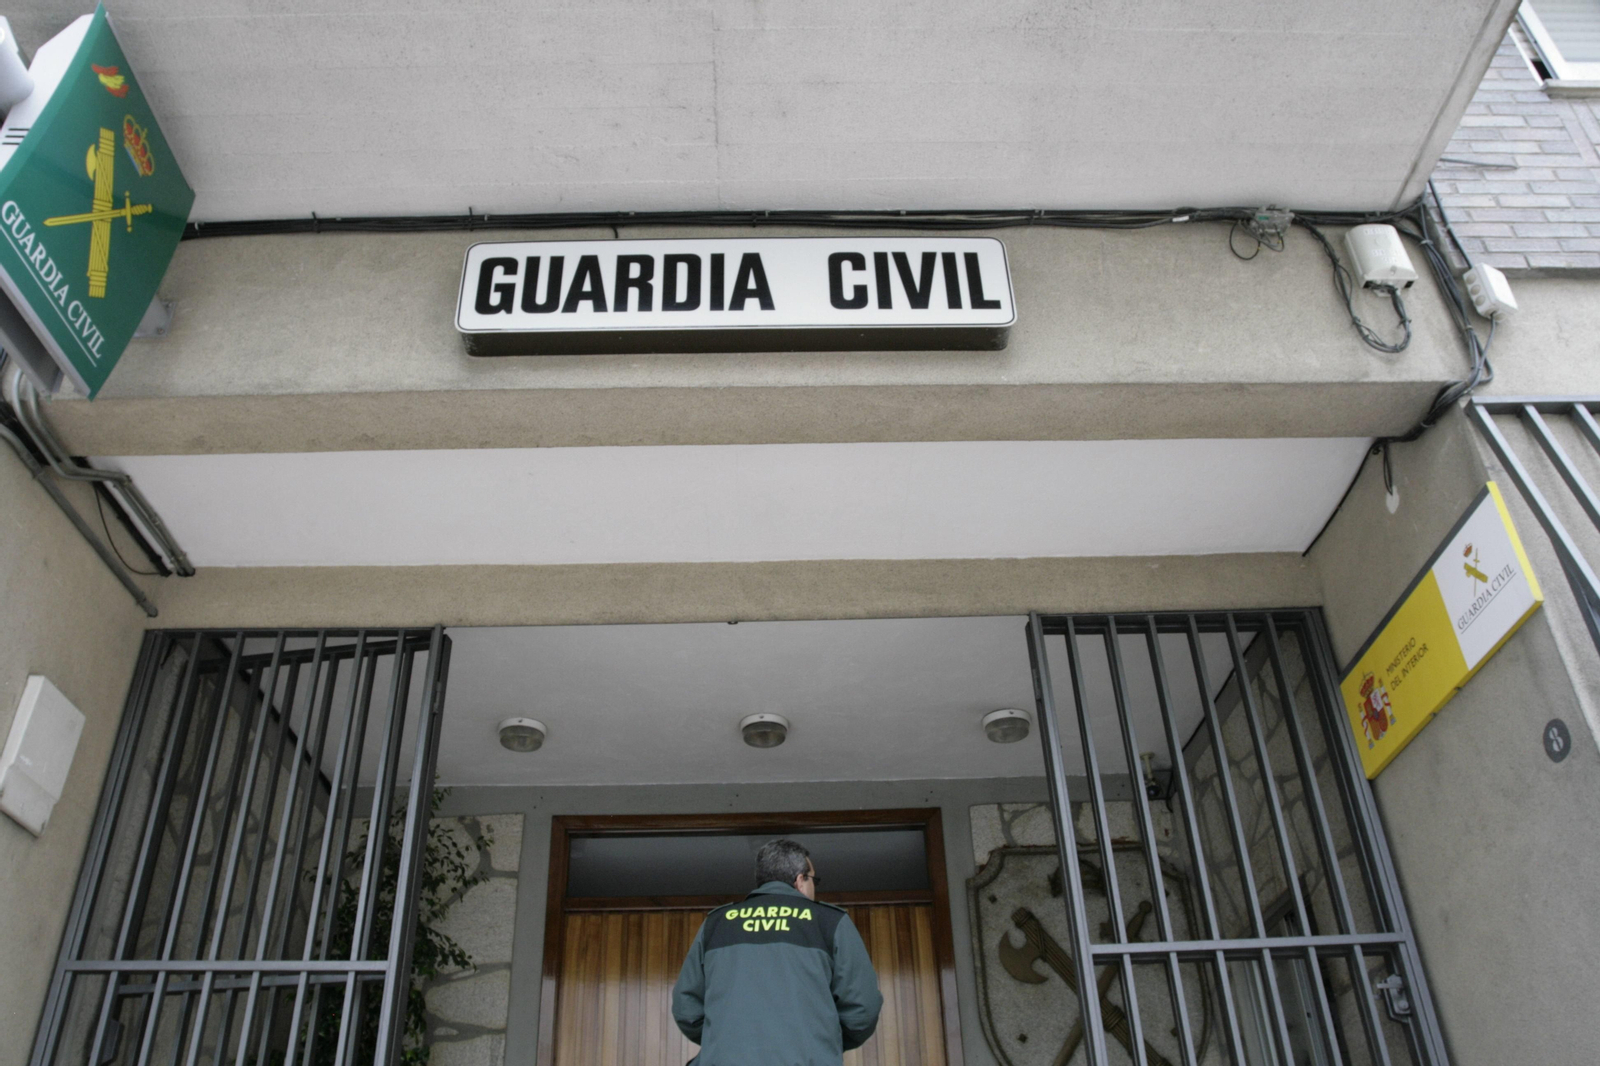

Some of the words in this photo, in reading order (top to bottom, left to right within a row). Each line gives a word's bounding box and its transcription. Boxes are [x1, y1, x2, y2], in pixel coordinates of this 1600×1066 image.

[1, 200, 70, 307] GUARDIA
[68, 300, 104, 358] CIVIL
[475, 252, 775, 315] GUARDIA
[828, 251, 1002, 310] CIVIL
[1457, 589, 1492, 630] GUARDIA
[1491, 564, 1515, 593] CIVIL
[1385, 637, 1416, 676] MINISTERIO
[1390, 669, 1403, 691] DEL
[1401, 643, 1429, 680] INTERIOR
[1549, 727, 1564, 752] 8
[725, 906, 812, 921] GUARDIA
[743, 918, 790, 932] CIVIL
